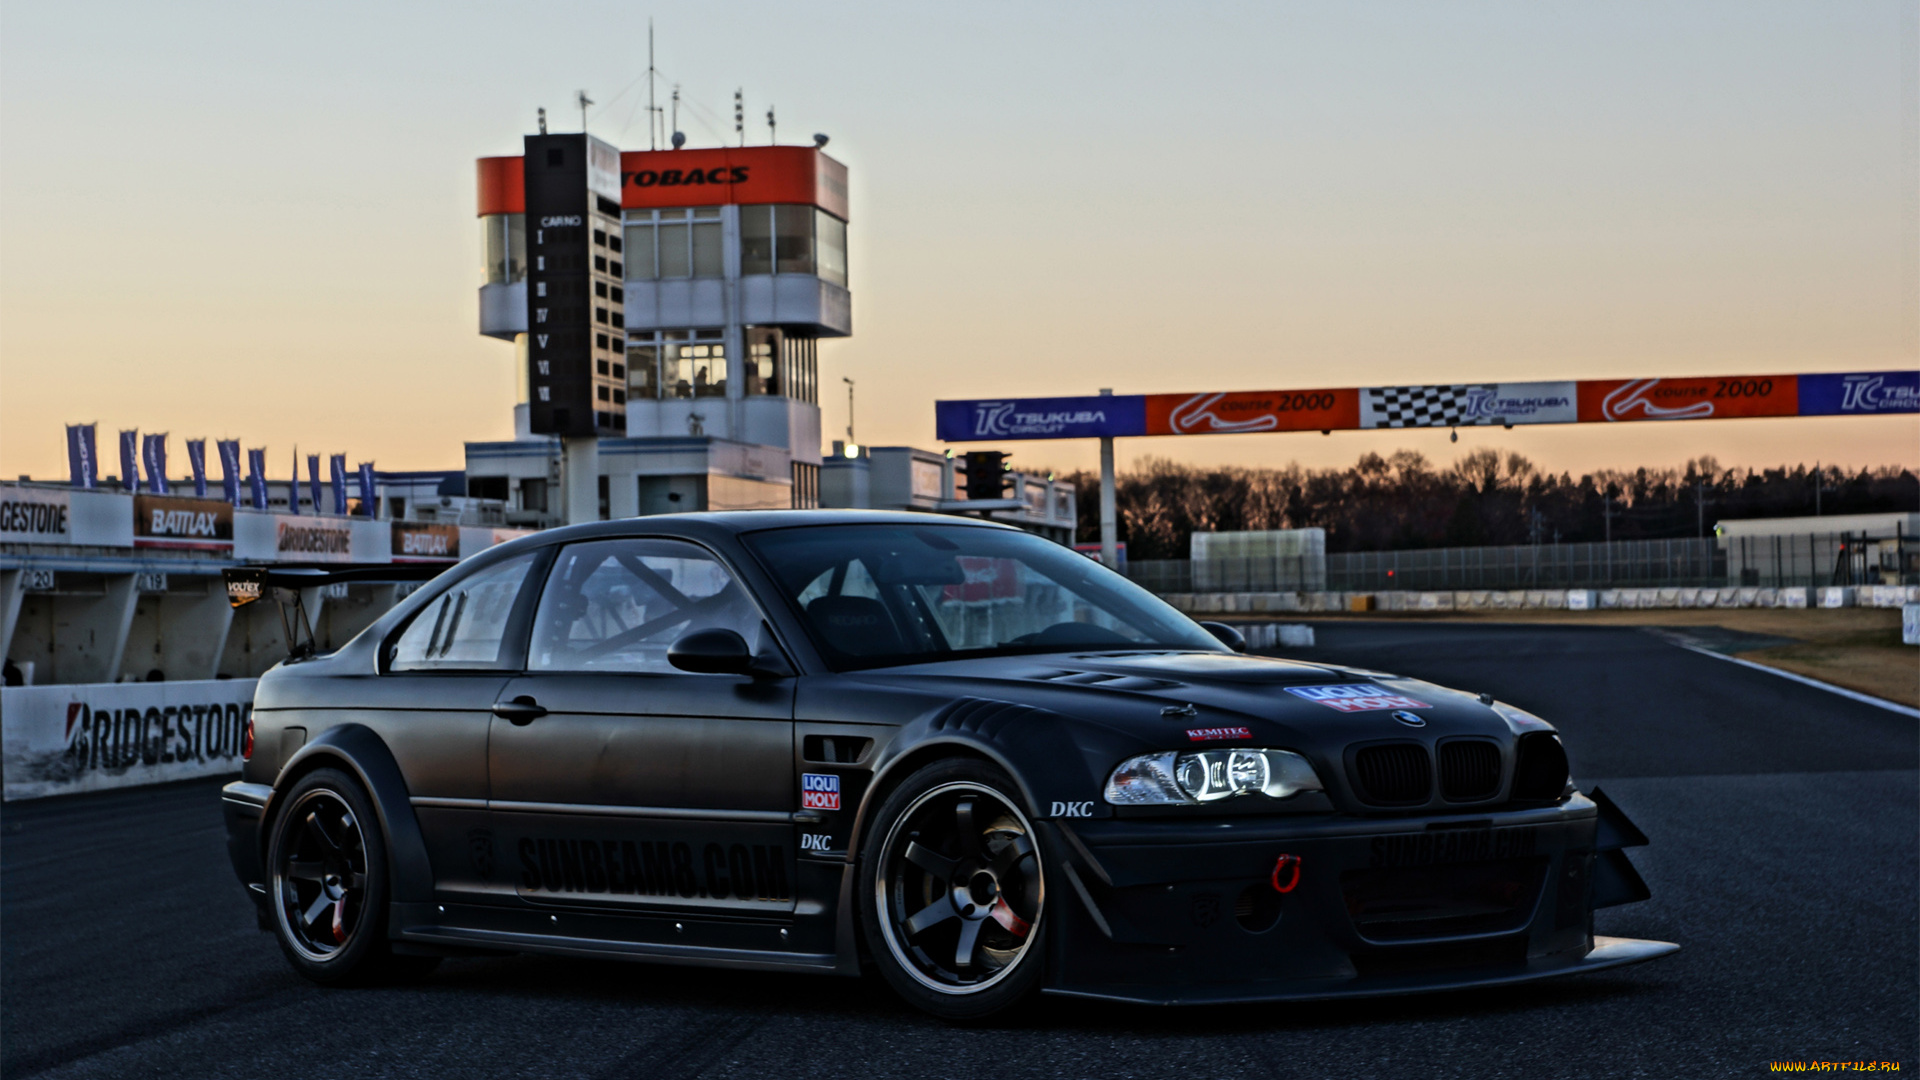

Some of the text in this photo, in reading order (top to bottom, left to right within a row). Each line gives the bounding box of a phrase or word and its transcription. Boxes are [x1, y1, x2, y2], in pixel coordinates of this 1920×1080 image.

[537, 334, 549, 350] V
[1653, 380, 1773, 398] course 2000
[1220, 393, 1334, 412] course 2000
[1498, 397, 1569, 408] TSUKUBA
[1013, 411, 1106, 424] TSUKUBA
[1009, 423, 1066, 434] CIRCUIT
[278, 523, 350, 553] BRIDGESTONE
[34, 570, 50, 588] 20
[227, 580, 260, 592] VOLTEX
[1187, 726, 1249, 737] KEMITEC
[804, 775, 837, 792] LIQUI
[804, 792, 838, 808] MOLY
[1050, 800, 1095, 817] DKC
[800, 833, 832, 851] DKC
[518, 837, 789, 901] SUNBEAM8.COM
